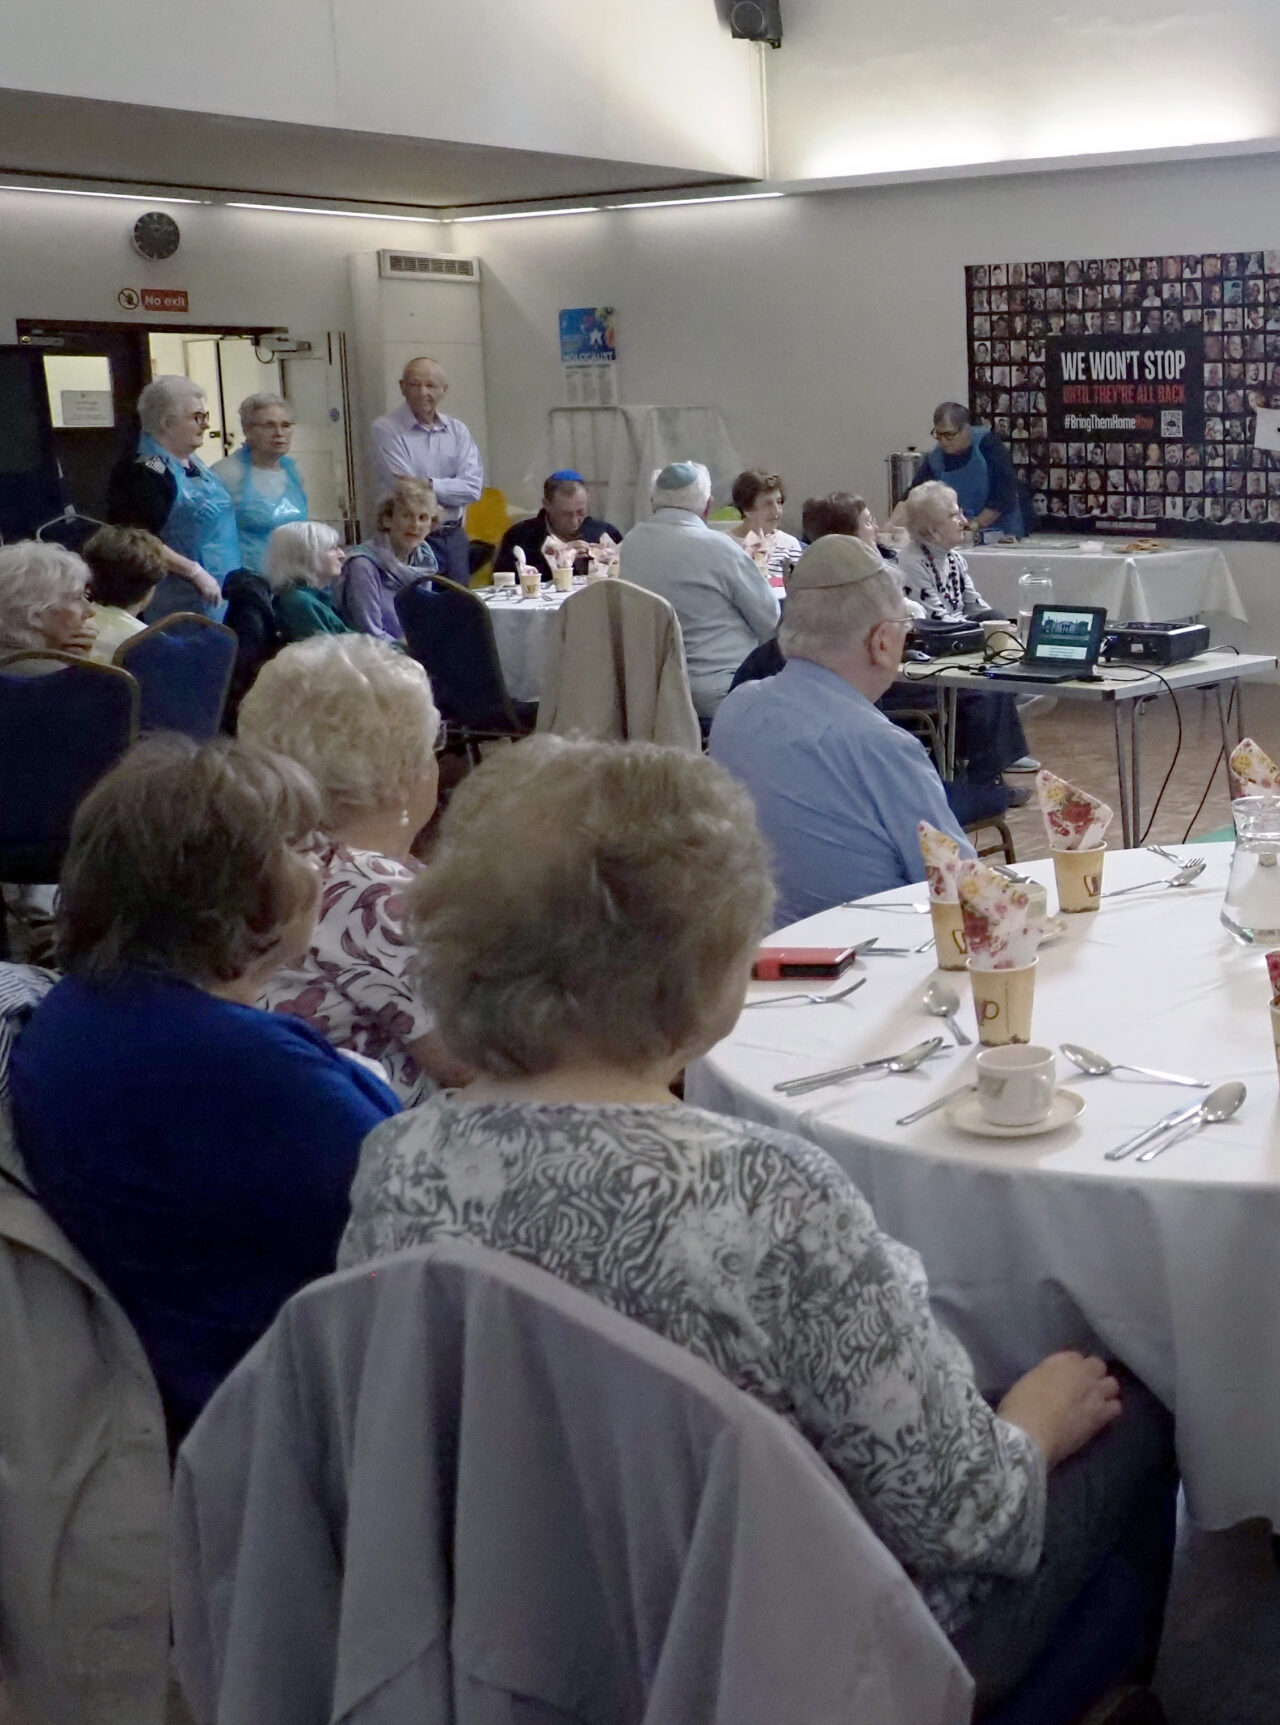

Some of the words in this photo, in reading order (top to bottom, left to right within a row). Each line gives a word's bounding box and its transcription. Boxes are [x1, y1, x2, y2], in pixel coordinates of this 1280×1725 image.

[145, 294, 161, 306] No
[164, 295, 185, 306] exit
[1061, 351, 1087, 381] WE
[1089, 350, 1140, 380] WON'T
[1144, 349, 1186, 380] STOP
[1063, 384, 1089, 404] UNTIL
[1093, 384, 1135, 404] THEY'RE
[1137, 384, 1154, 404] ALL
[1158, 383, 1186, 404] BACK
